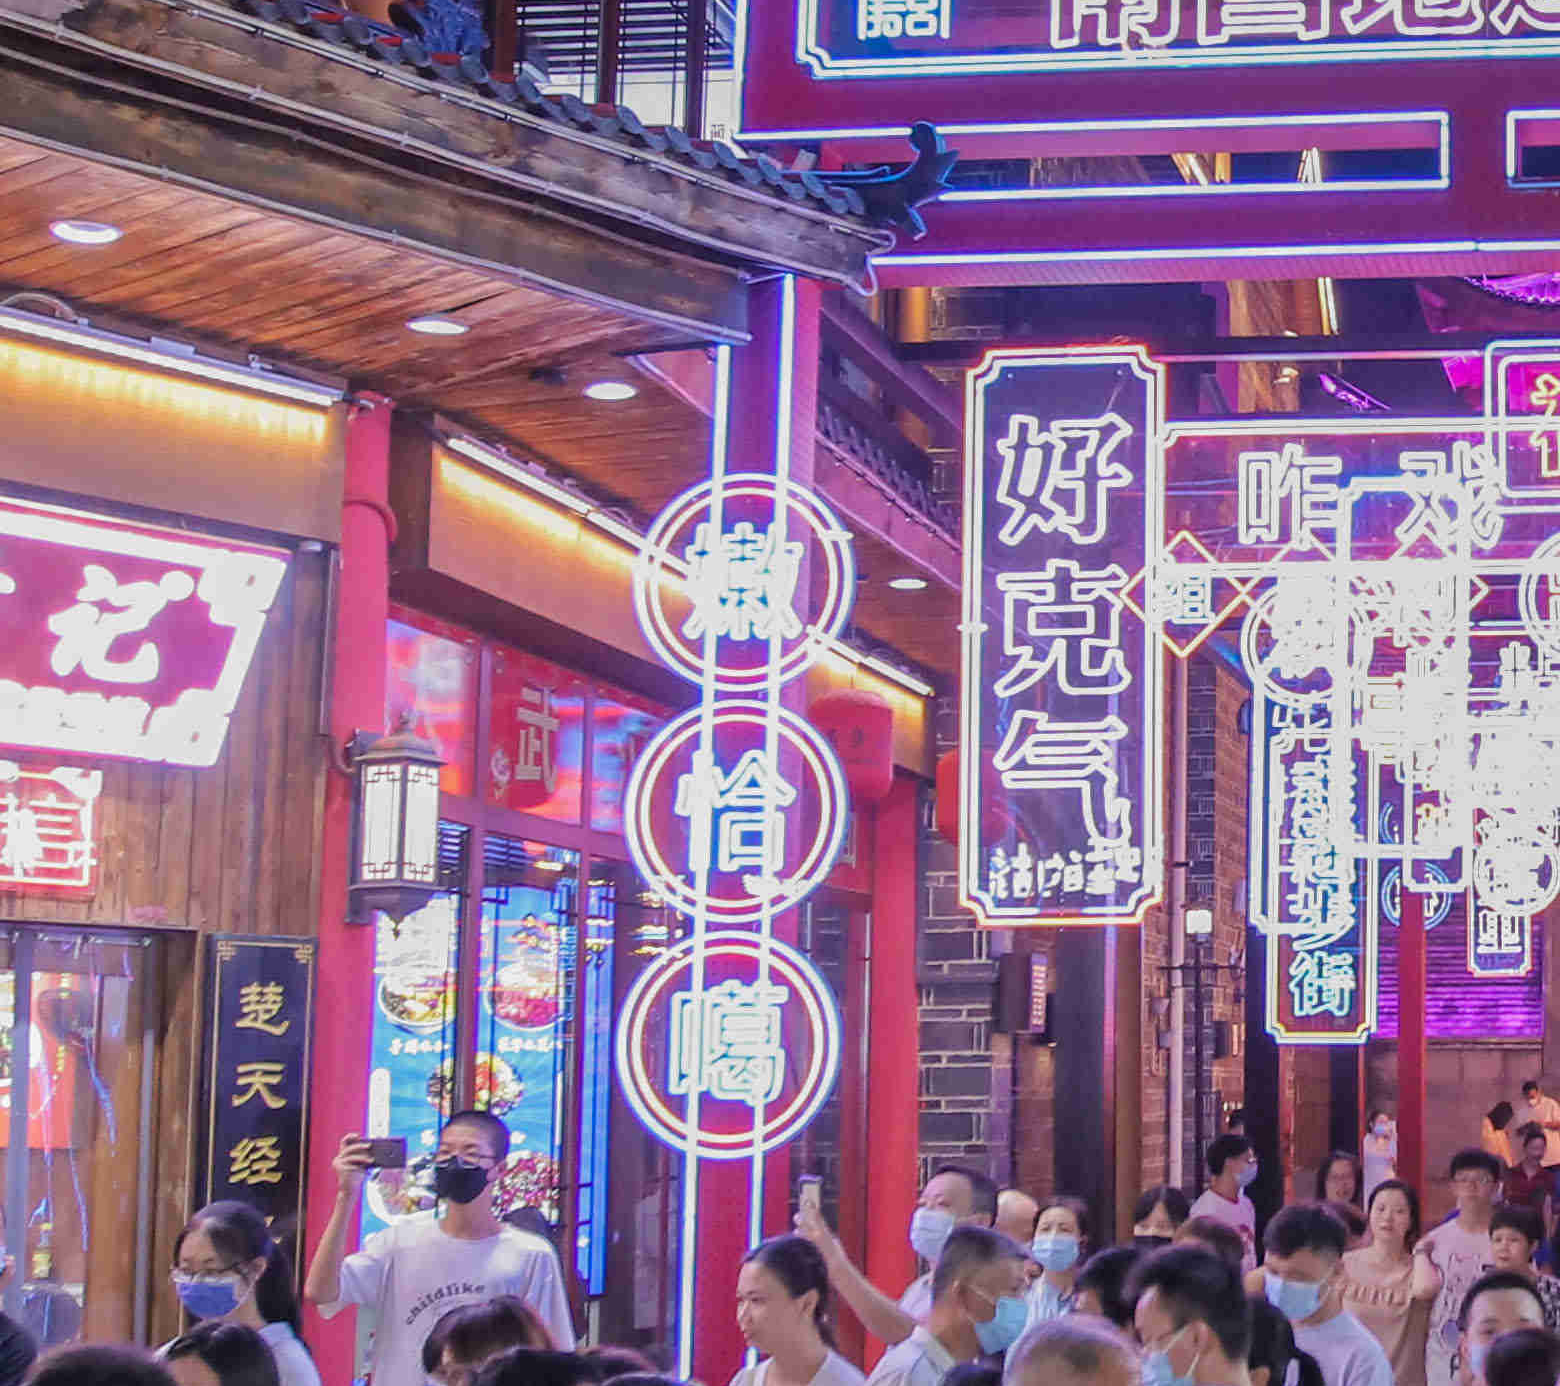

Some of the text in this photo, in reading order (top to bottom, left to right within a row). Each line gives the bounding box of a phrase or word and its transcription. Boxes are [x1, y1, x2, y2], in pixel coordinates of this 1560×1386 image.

[994, 413, 1137, 850] 好克气
[229, 982, 290, 1247] 楚天经
[405, 1281, 486, 1326] childlike
